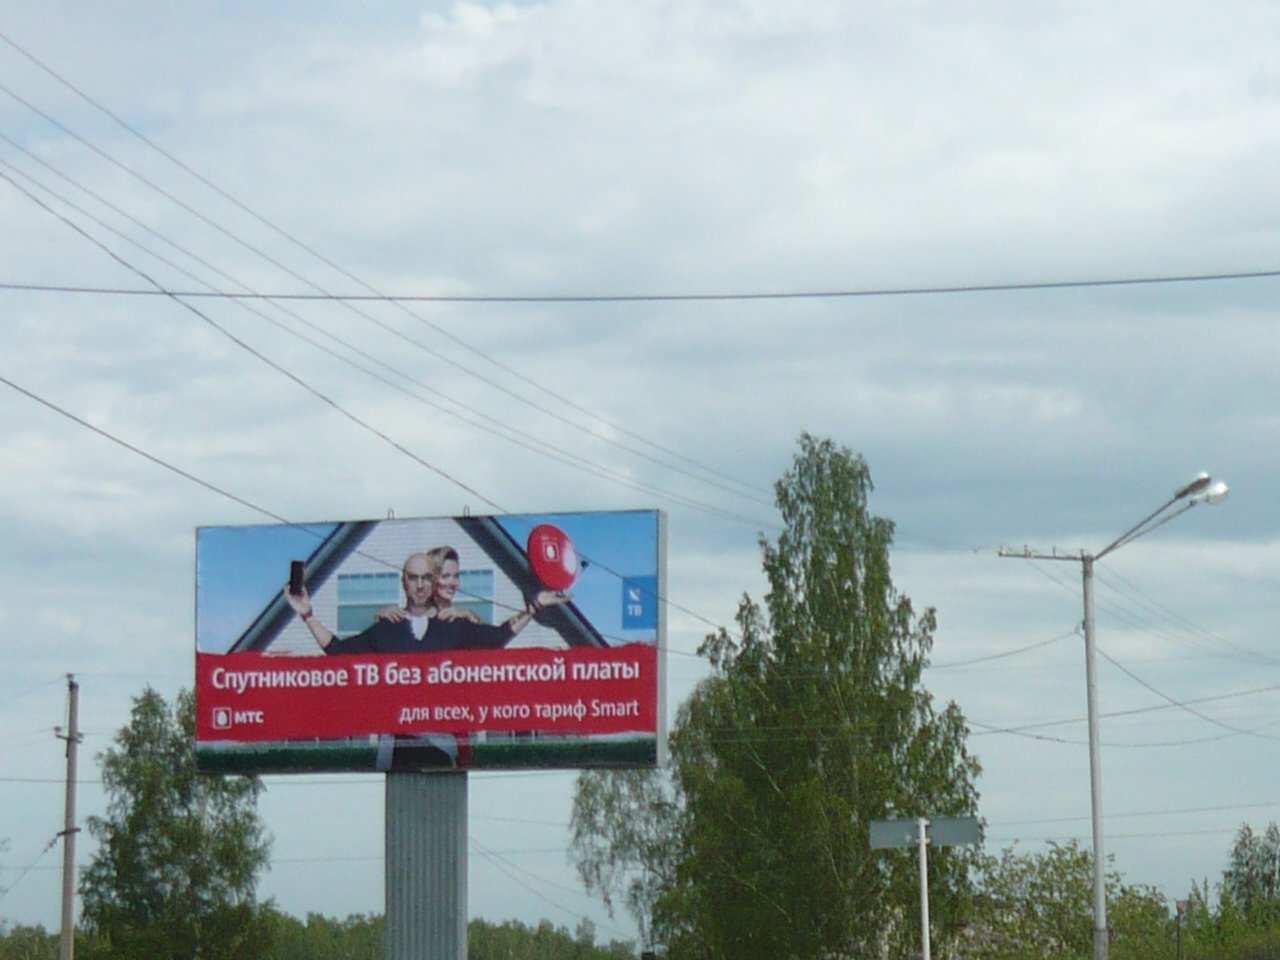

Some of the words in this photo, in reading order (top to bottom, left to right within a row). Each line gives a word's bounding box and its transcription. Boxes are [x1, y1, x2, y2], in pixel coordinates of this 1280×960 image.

[627, 603, 643, 617] ТВ
[212, 666, 349, 695] Спутниковое
[353, 663, 380, 686] ТВ
[384, 661, 422, 686] без
[427, 658, 567, 684] абонентской
[572, 660, 640, 682] платы
[399, 706, 430, 725] для
[434, 704, 475, 723] всех,
[478, 706, 489, 723] у
[492, 703, 530, 719] кого
[535, 699, 588, 722] тариф
[591, 699, 641, 718] Smart
